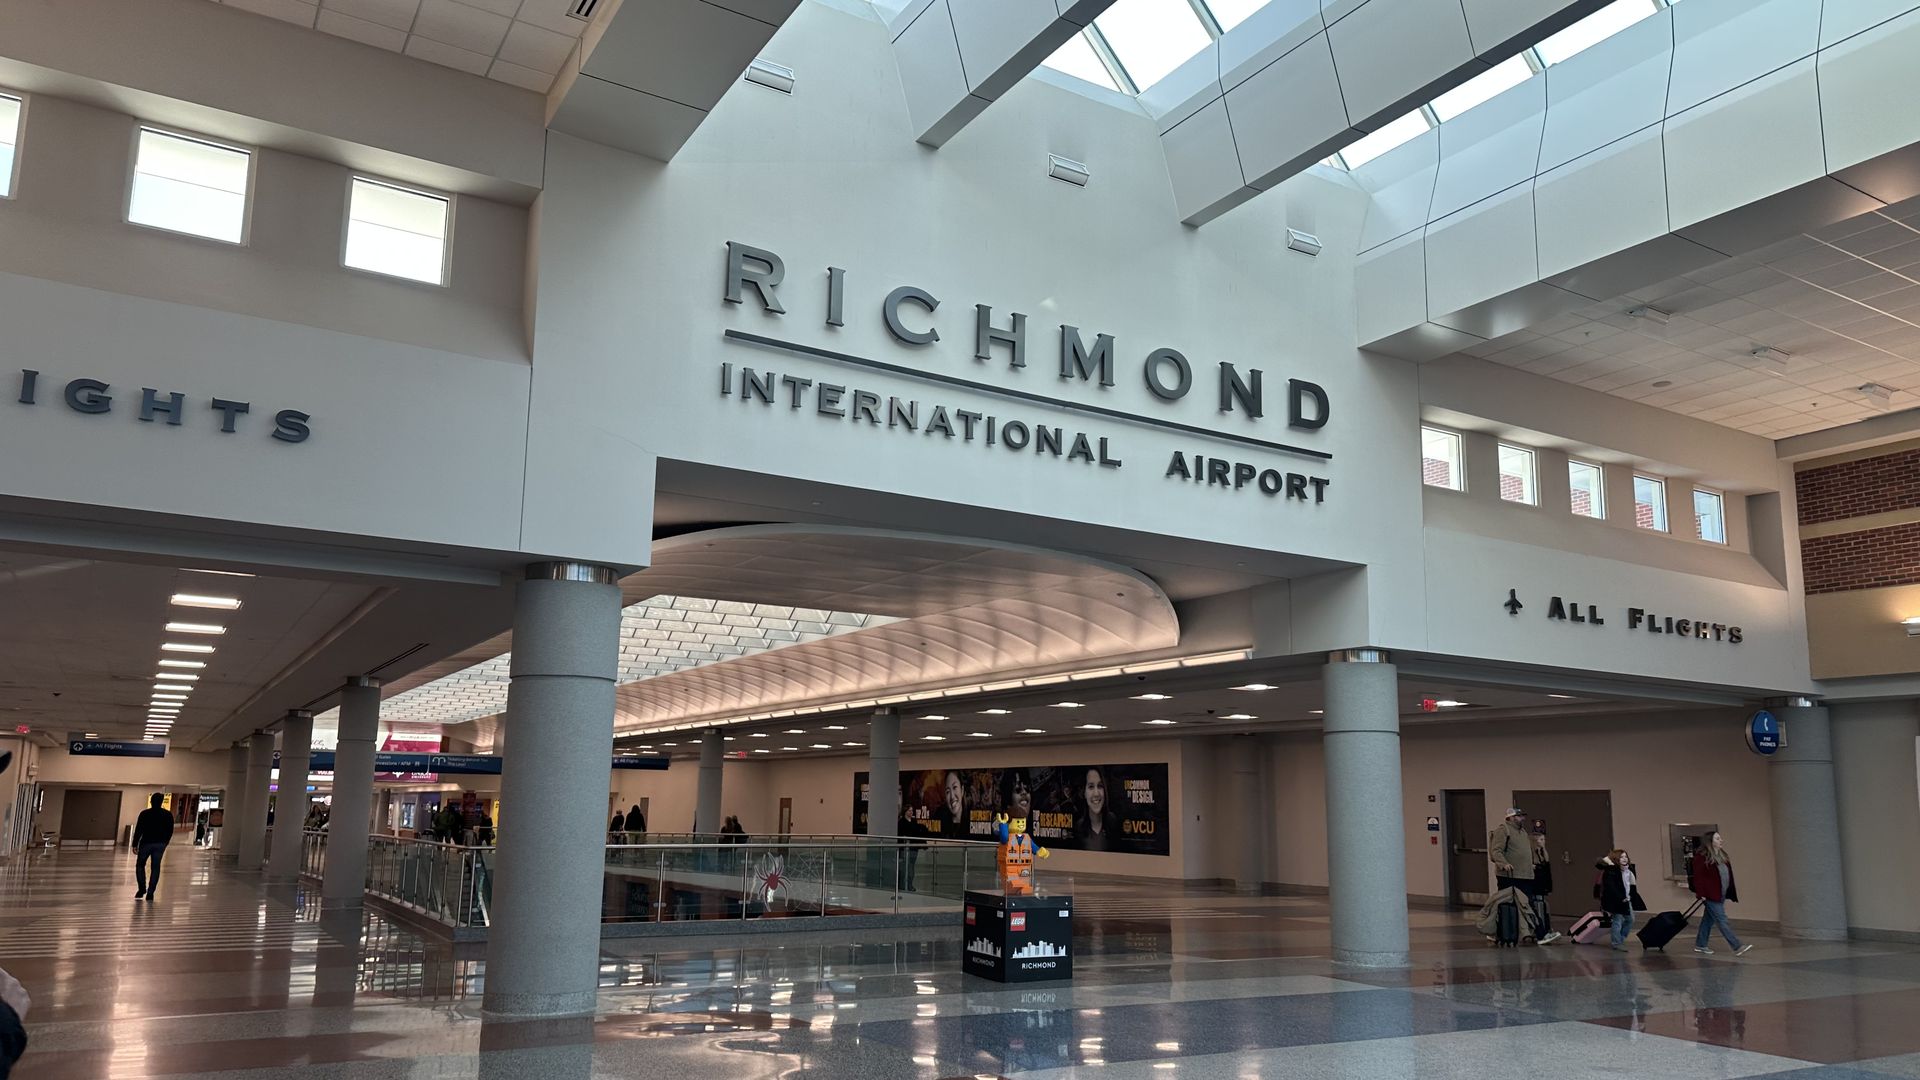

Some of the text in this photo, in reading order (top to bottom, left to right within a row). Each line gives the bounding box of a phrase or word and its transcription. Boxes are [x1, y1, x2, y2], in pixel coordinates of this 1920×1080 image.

[724, 240, 1331, 430] RICHMOND
[721, 362, 1330, 503] INTERNATIONAL AIRPORT
[1548, 596, 1743, 644] ALL FLIGHTS
[1132, 820, 1155, 834] VCU
[1021, 961, 1057, 970] RICHMOND
